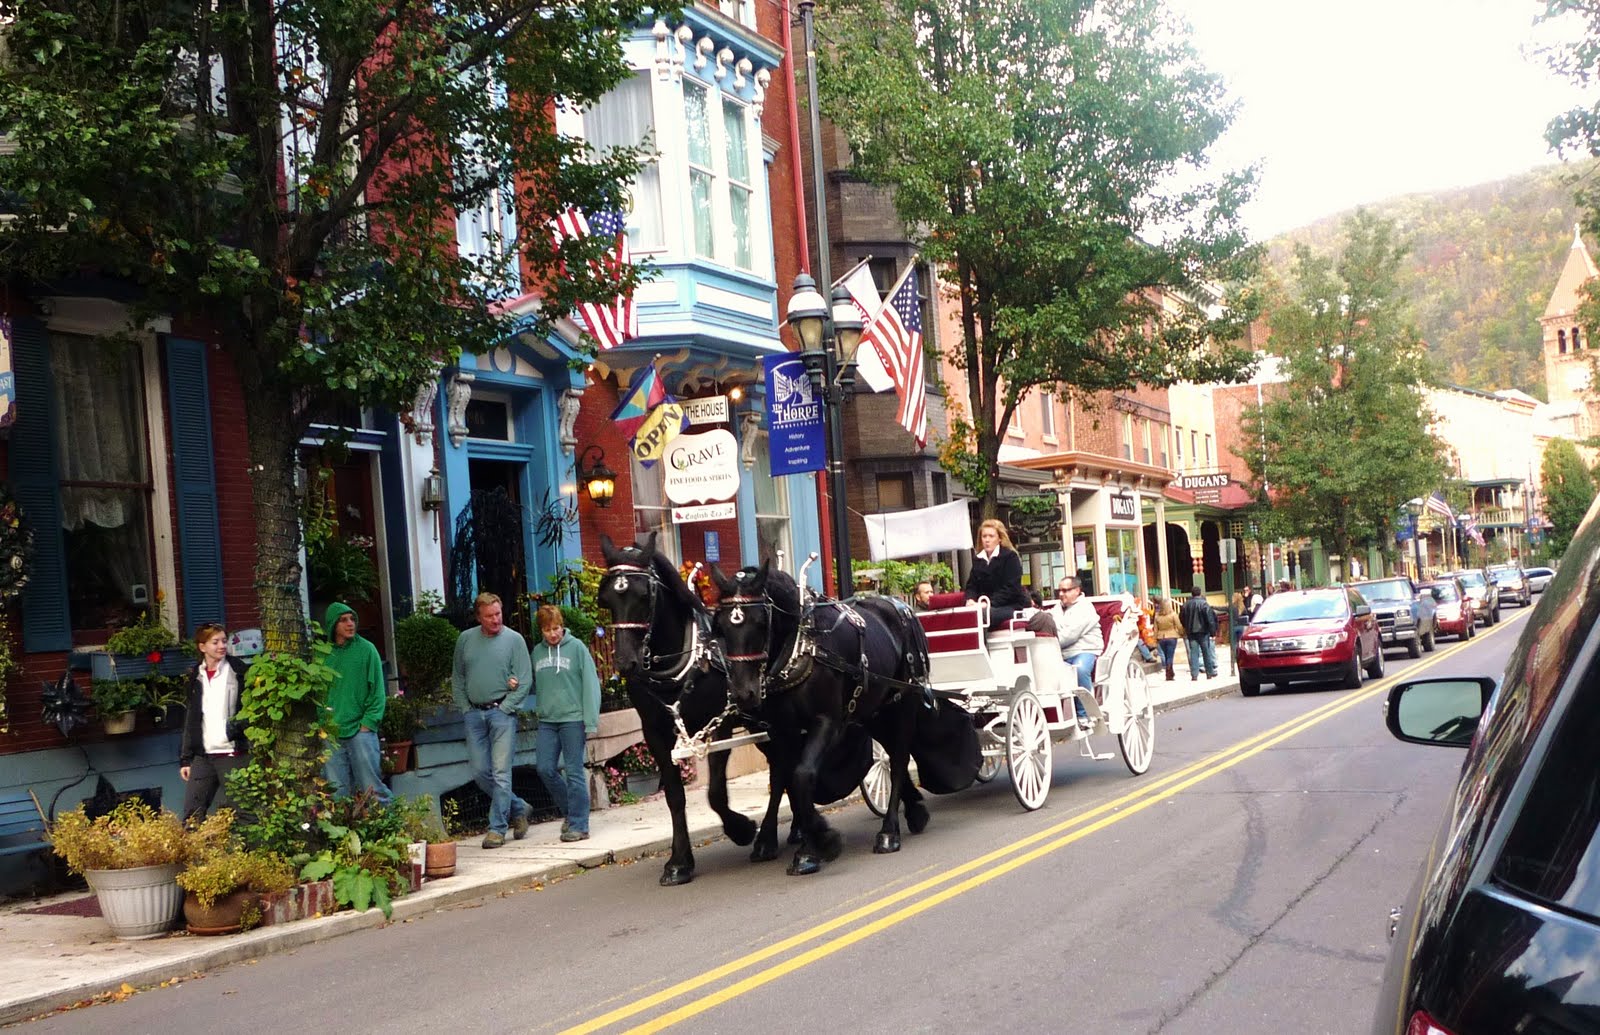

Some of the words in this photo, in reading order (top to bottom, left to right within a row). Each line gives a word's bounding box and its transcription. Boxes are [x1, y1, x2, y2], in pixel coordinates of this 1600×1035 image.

[701, 402, 724, 418] HOUSE
[772, 403, 783, 413] JIM
[774, 403, 819, 425] THORPE
[636, 406, 680, 458] OPEN
[784, 445, 811, 453] Adventure
[670, 477, 683, 485] FINE
[685, 476, 701, 484] FOOD
[709, 473, 732, 482] SPIRITS
[1184, 475, 1228, 488] DUGAN'S
[685, 511, 709, 520] English
